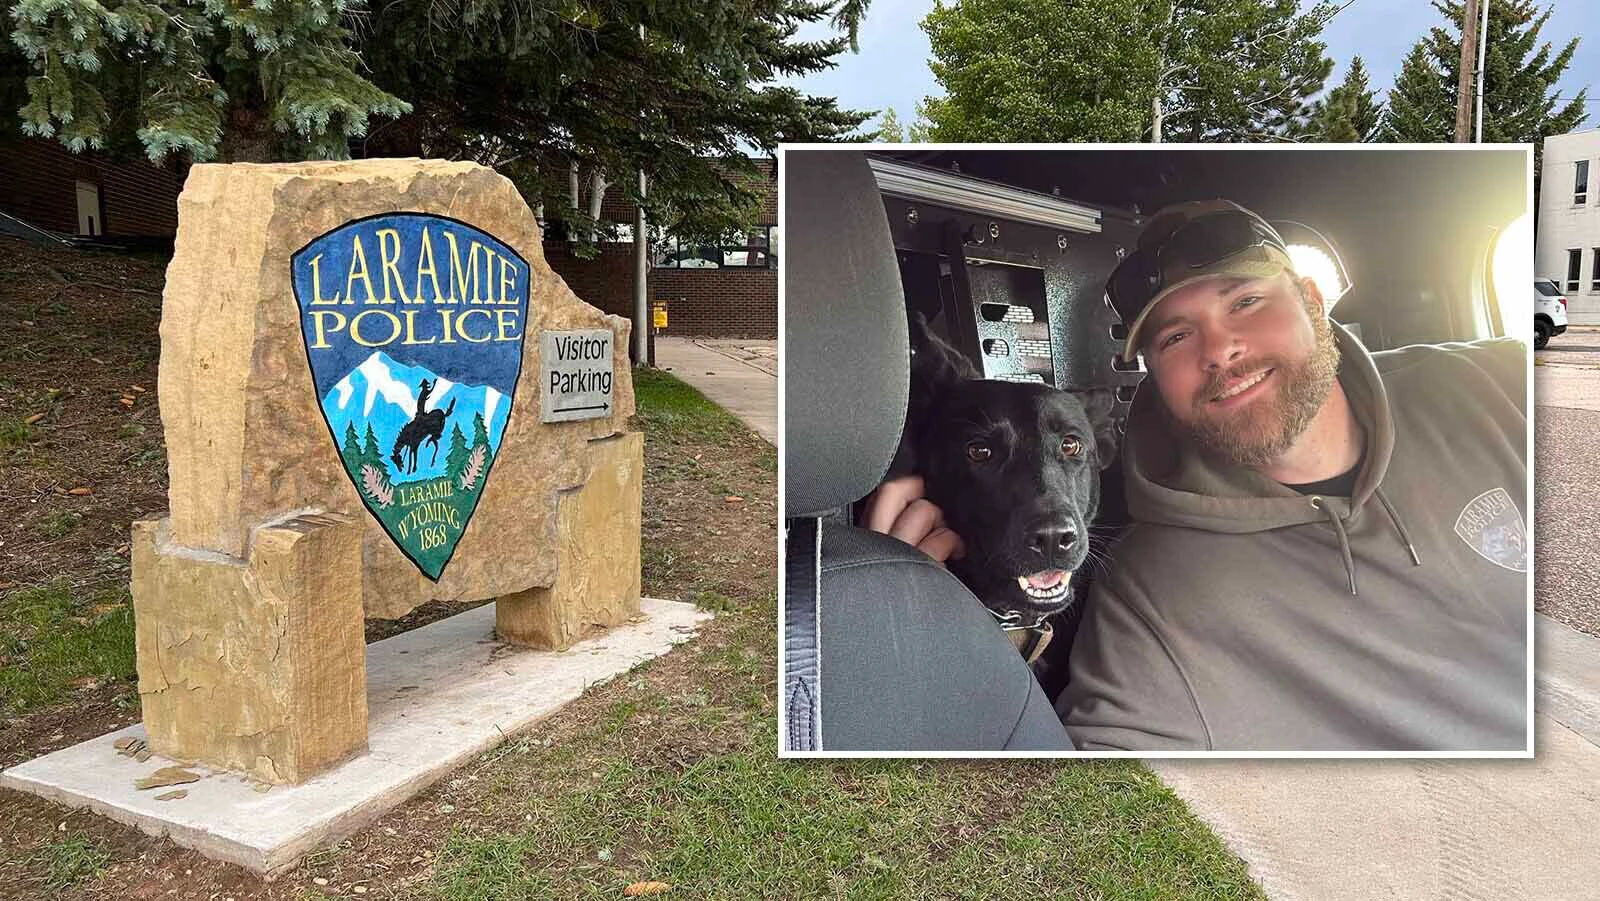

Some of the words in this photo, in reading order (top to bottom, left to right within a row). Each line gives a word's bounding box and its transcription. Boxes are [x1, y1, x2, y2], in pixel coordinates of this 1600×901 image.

[308, 226, 520, 306] LARAMIE
[308, 309, 522, 349] POLICE
[555, 336, 608, 360] Visitor
[550, 368, 612, 394] Parking
[400, 480, 454, 506] LARAMIE
[398, 502, 460, 540] WYOMING
[420, 523, 447, 551] 1868
